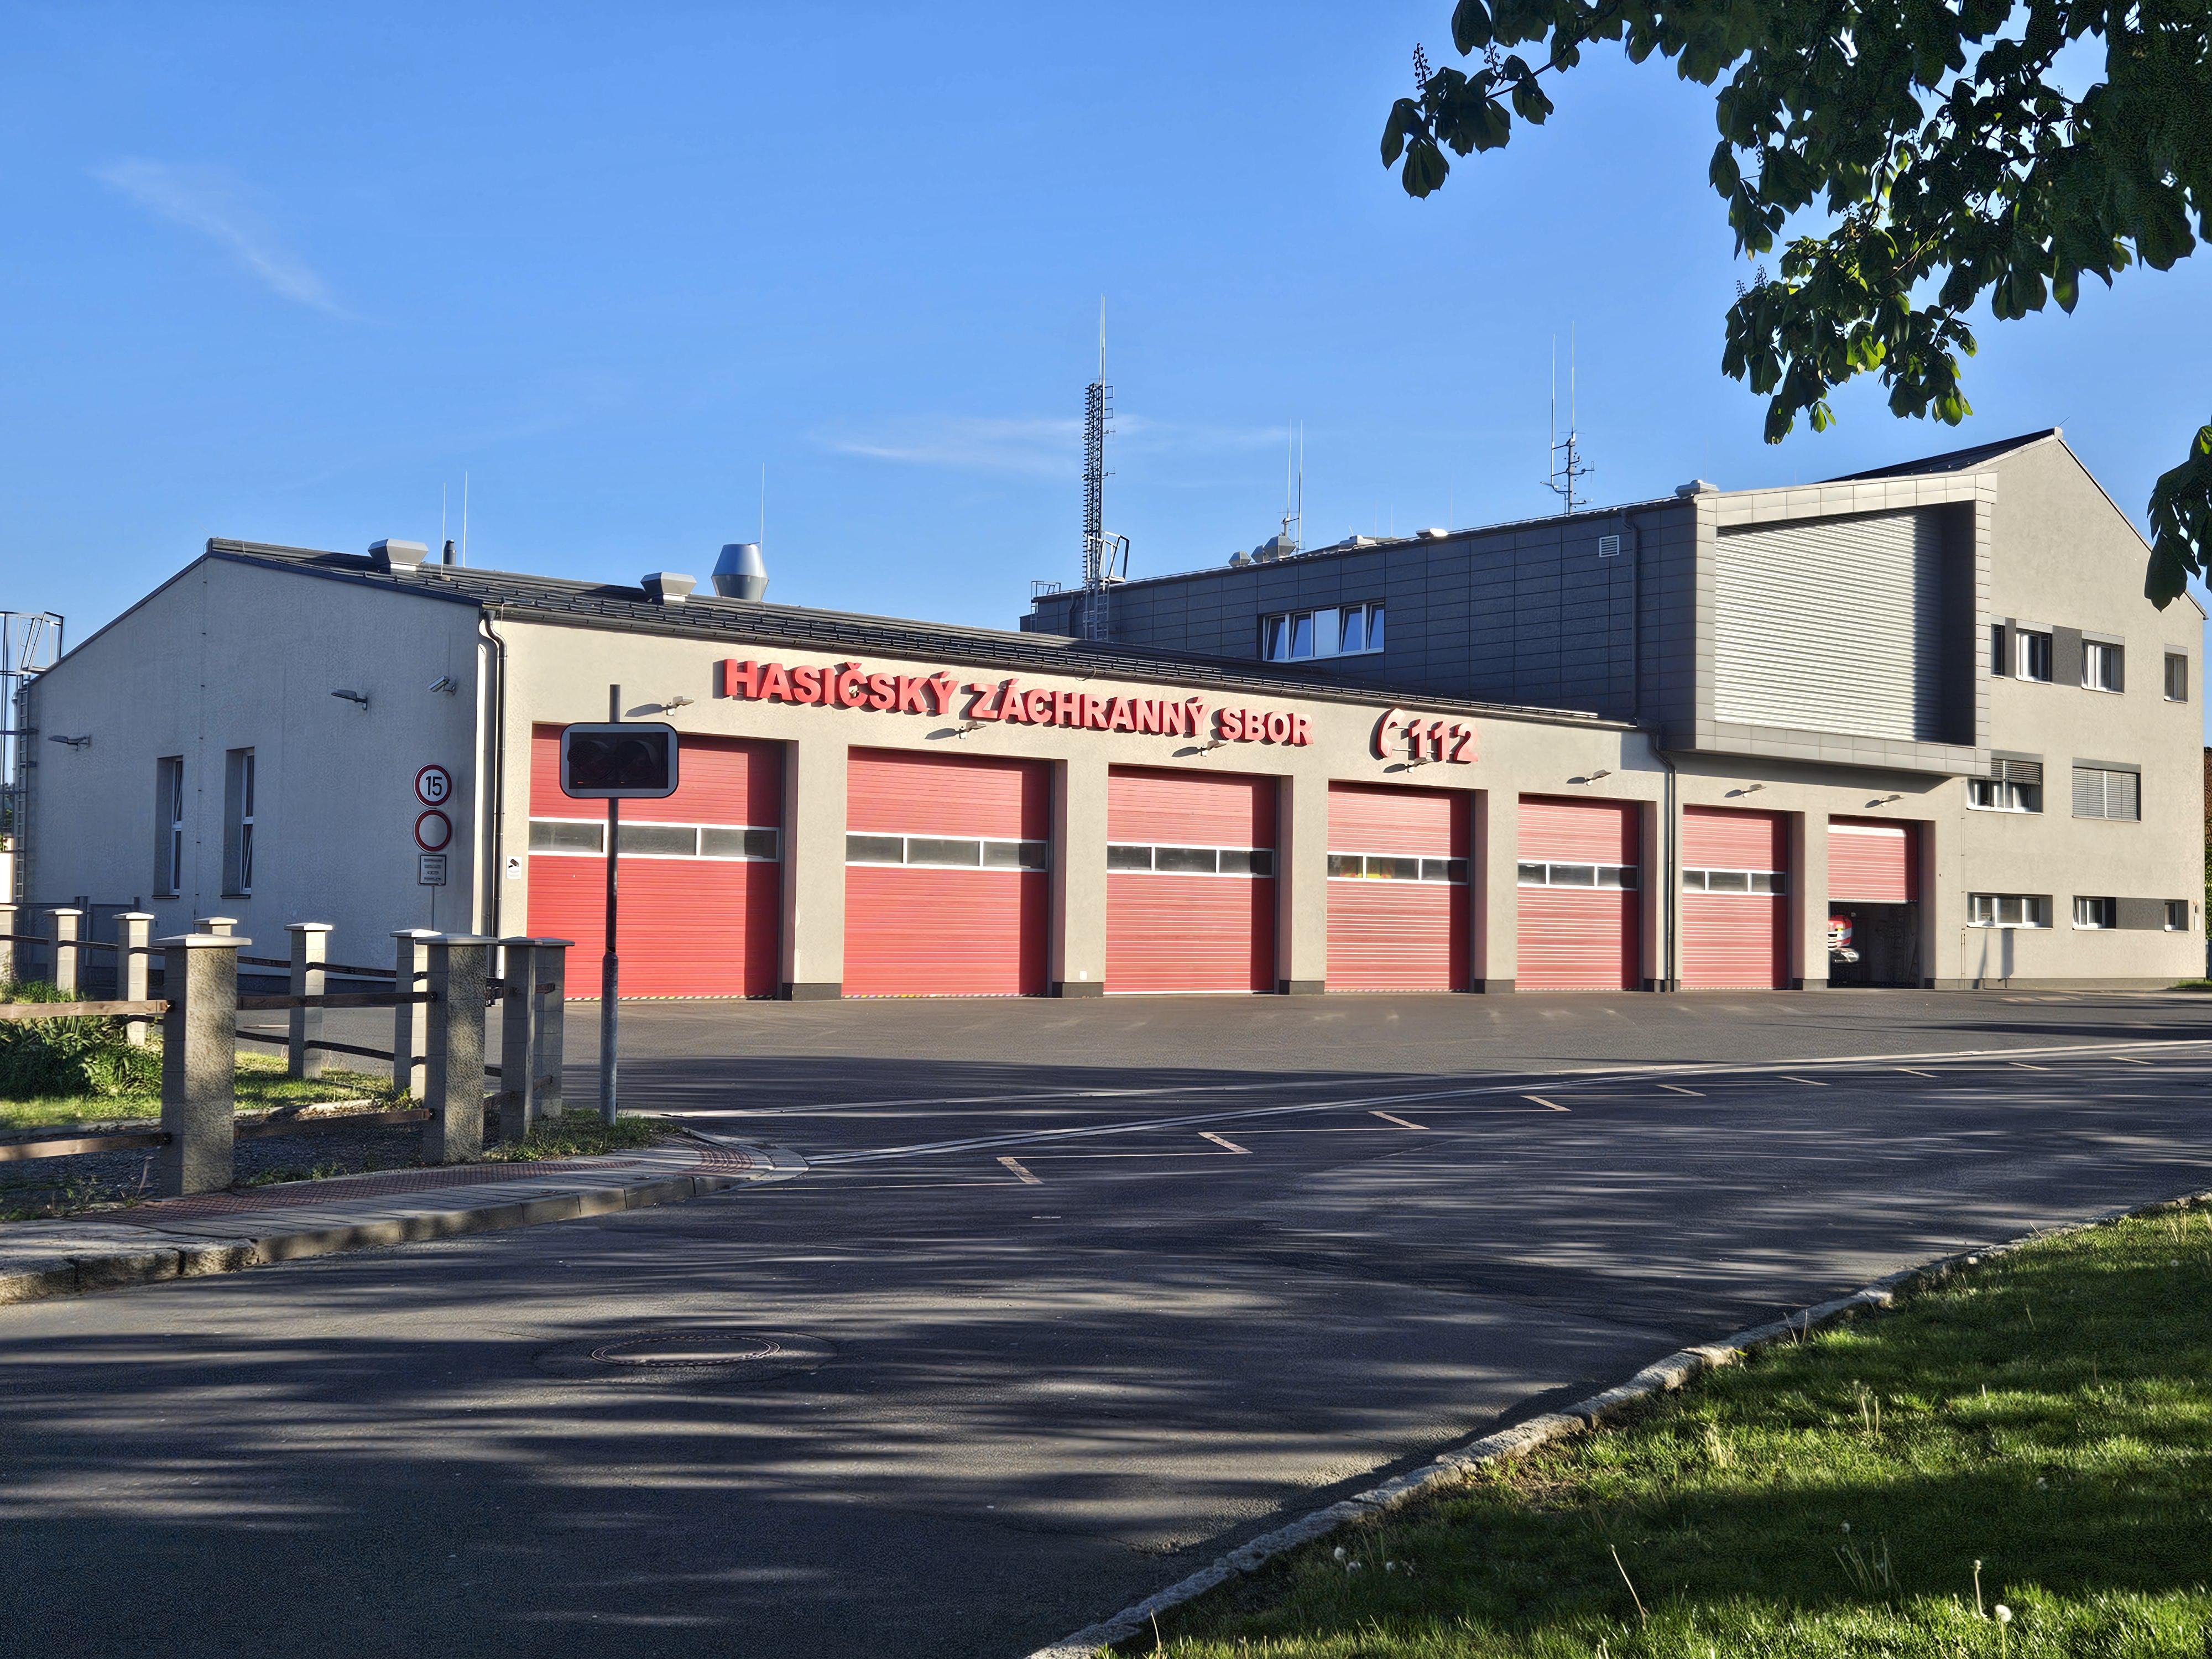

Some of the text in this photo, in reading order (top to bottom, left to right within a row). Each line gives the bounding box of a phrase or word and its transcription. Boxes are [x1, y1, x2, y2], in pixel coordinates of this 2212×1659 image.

[724, 659, 1313, 745] HASIČSKÝ ZÁCHRANNÝ SBOR
[1408, 719, 1478, 763] 112
[425, 776, 442, 796] 15
